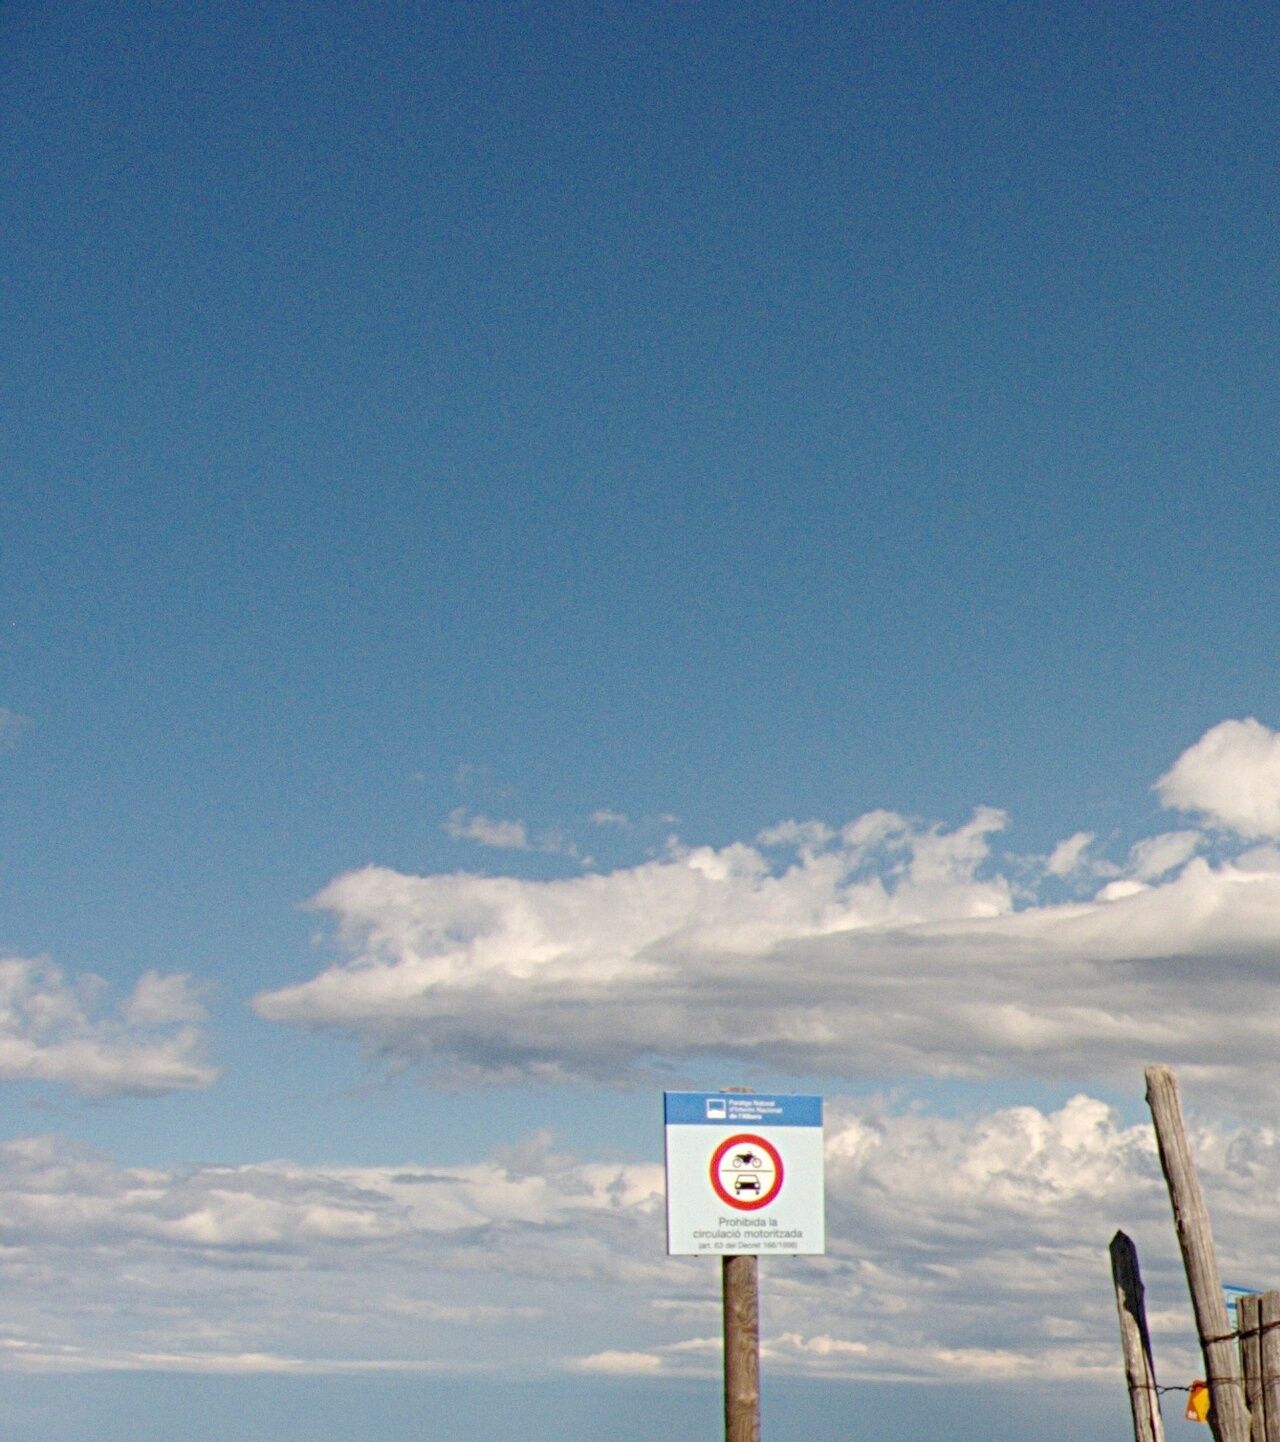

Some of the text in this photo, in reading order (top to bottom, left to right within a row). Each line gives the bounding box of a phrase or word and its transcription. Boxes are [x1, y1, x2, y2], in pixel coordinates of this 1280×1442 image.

[719, 1217, 778, 1228] Prohibida la
[693, 1228, 803, 1239] circulació motoritzada
